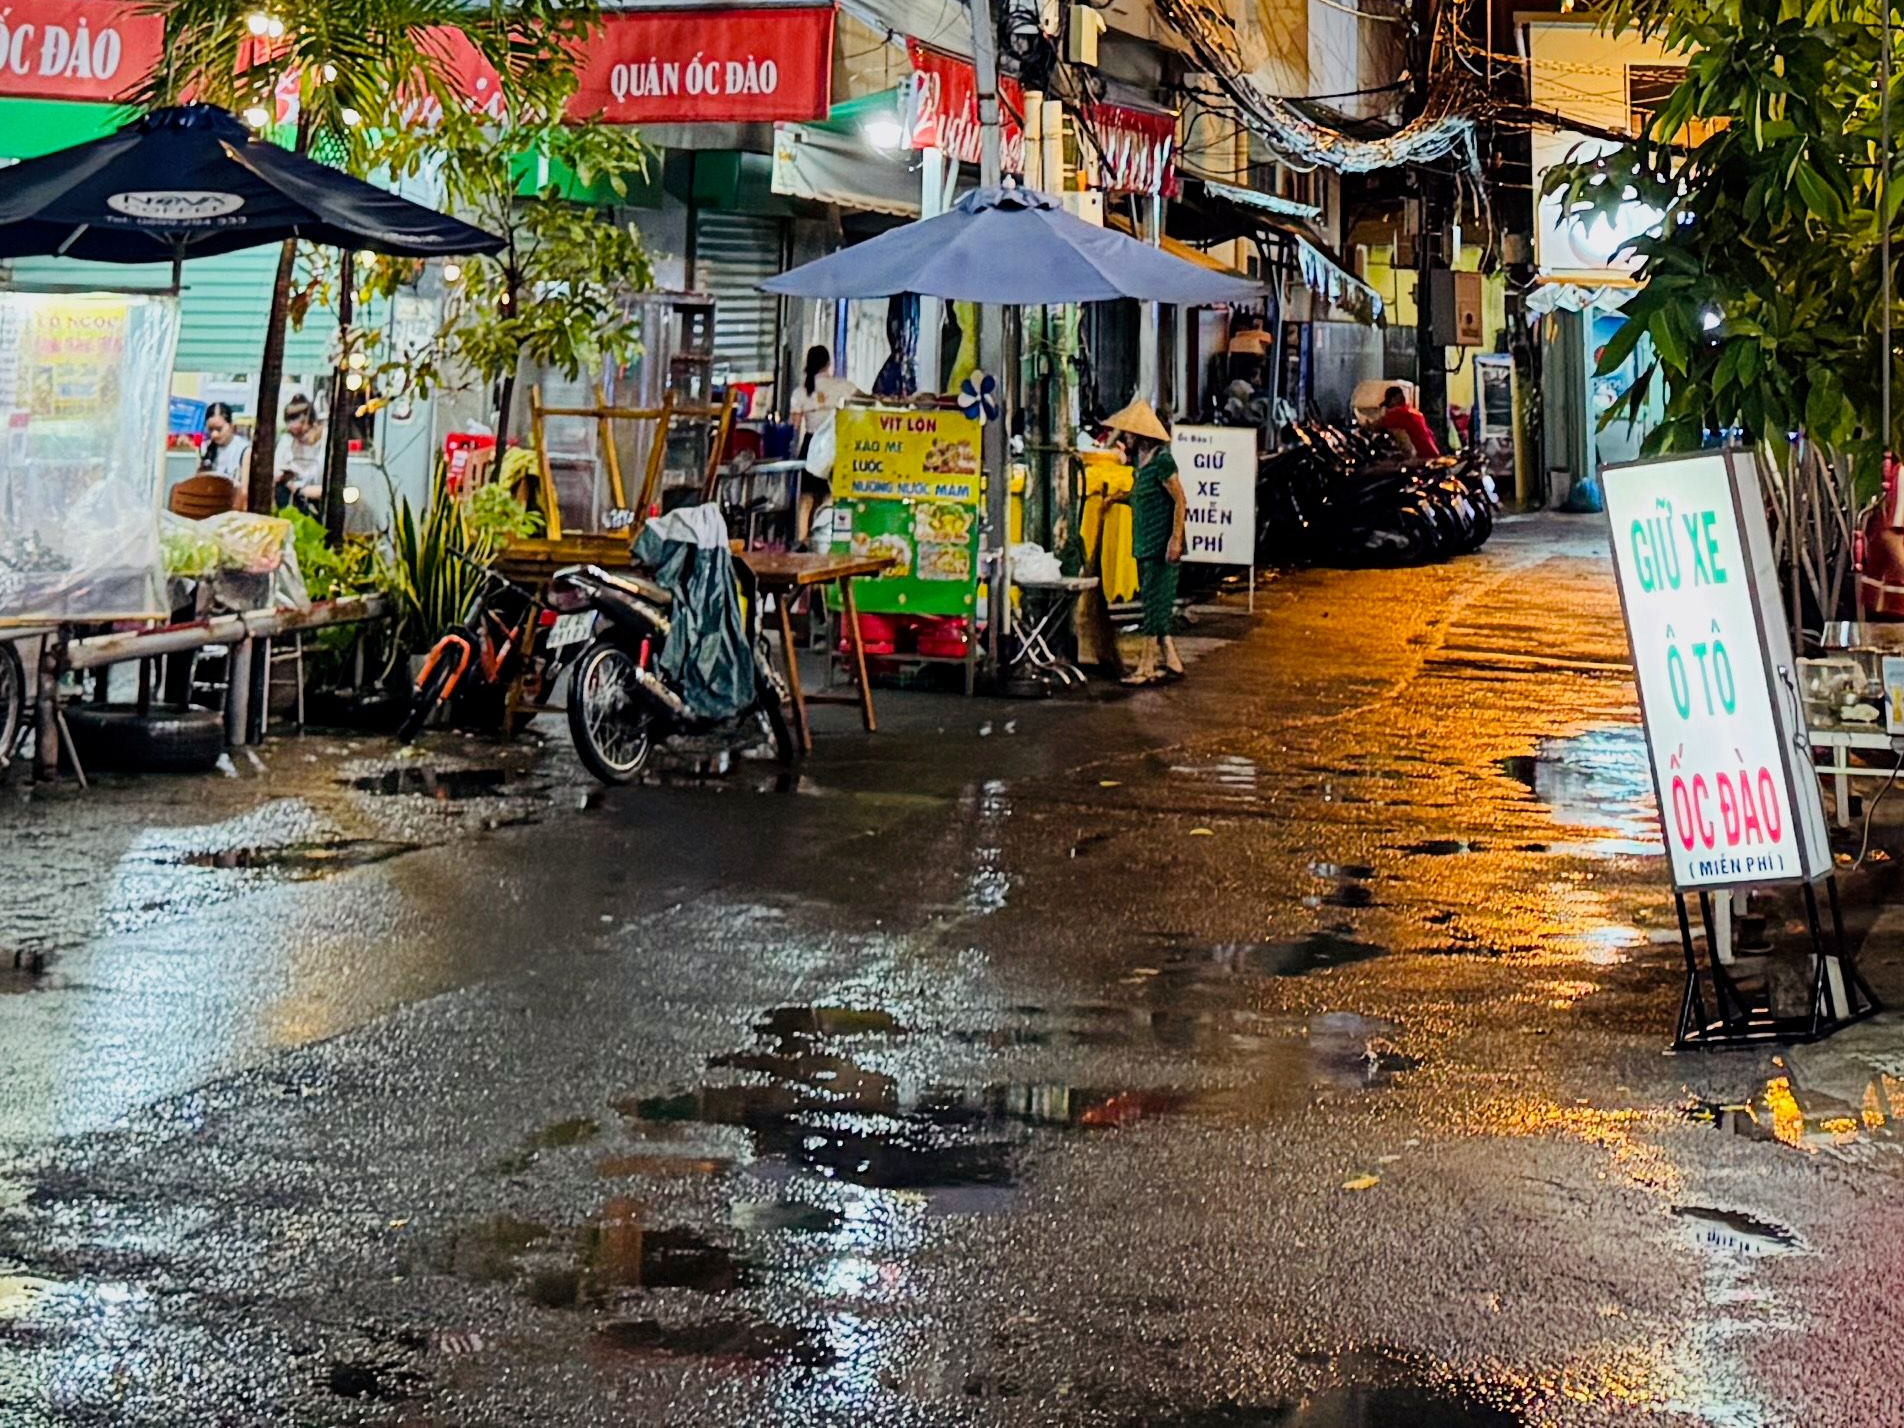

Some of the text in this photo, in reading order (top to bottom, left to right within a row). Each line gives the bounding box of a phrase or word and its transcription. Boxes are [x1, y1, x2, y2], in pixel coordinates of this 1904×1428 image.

[38, 16, 122, 81] ĐÀO
[610, 56, 681, 104] QUÁN
[686, 52, 722, 95] ỐC
[724, 59, 779, 95] ĐÀO
[1193, 450, 1226, 470] GIỮ
[1197, 480, 1221, 497] XE
[1192, 532, 1225, 553] PHÍ
[1681, 510, 1728, 587] XE
[1666, 618, 1736, 721] Ô TÔ
[1669, 743, 1783, 852] ỐC ĐÀO
